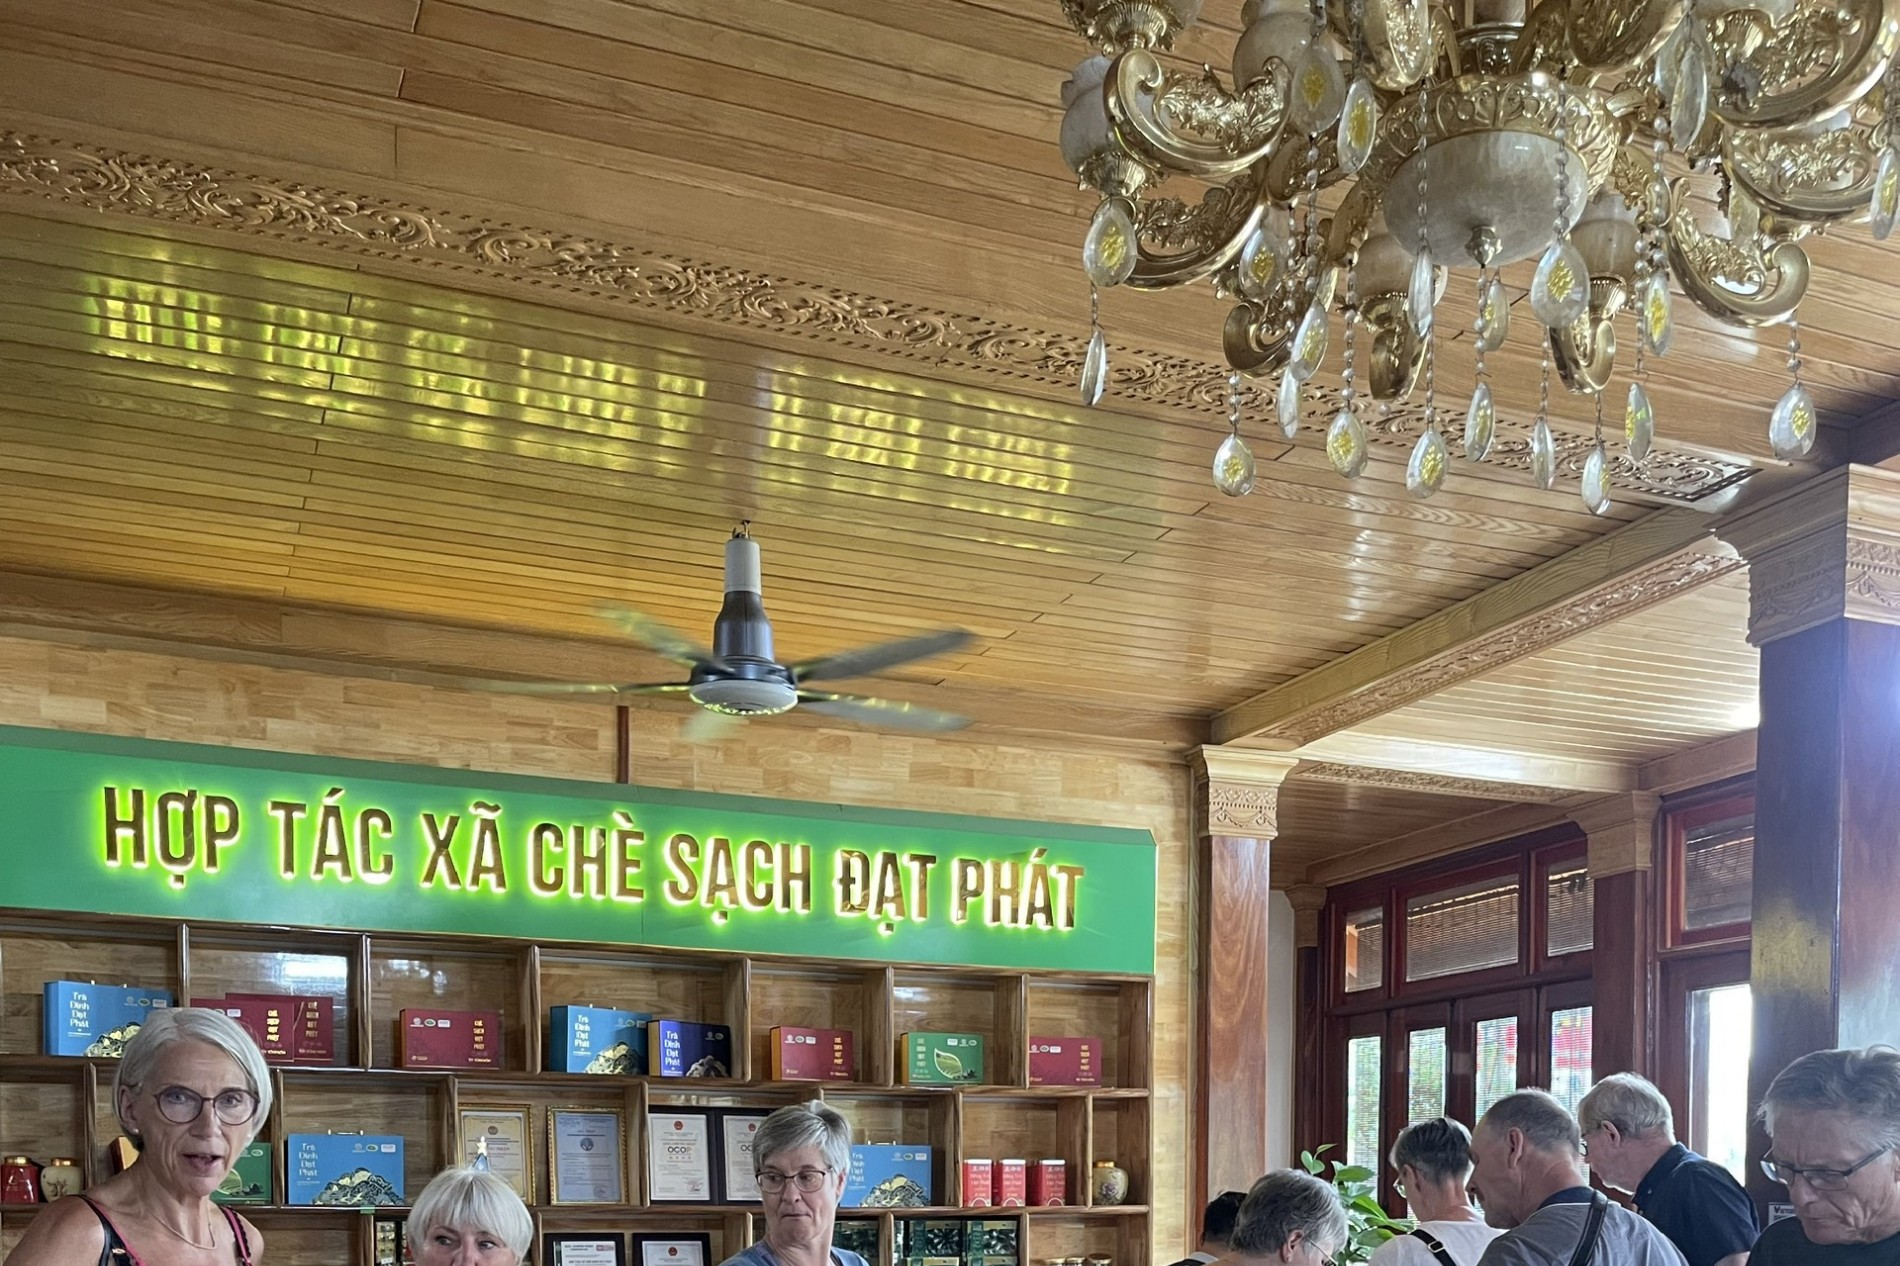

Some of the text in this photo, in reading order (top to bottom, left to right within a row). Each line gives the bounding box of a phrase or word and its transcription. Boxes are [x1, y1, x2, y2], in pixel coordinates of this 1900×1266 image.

[103, 787, 1085, 936] HỢP TÁC XÃ CHÈ SẠCH ĐẠT PHÁT
